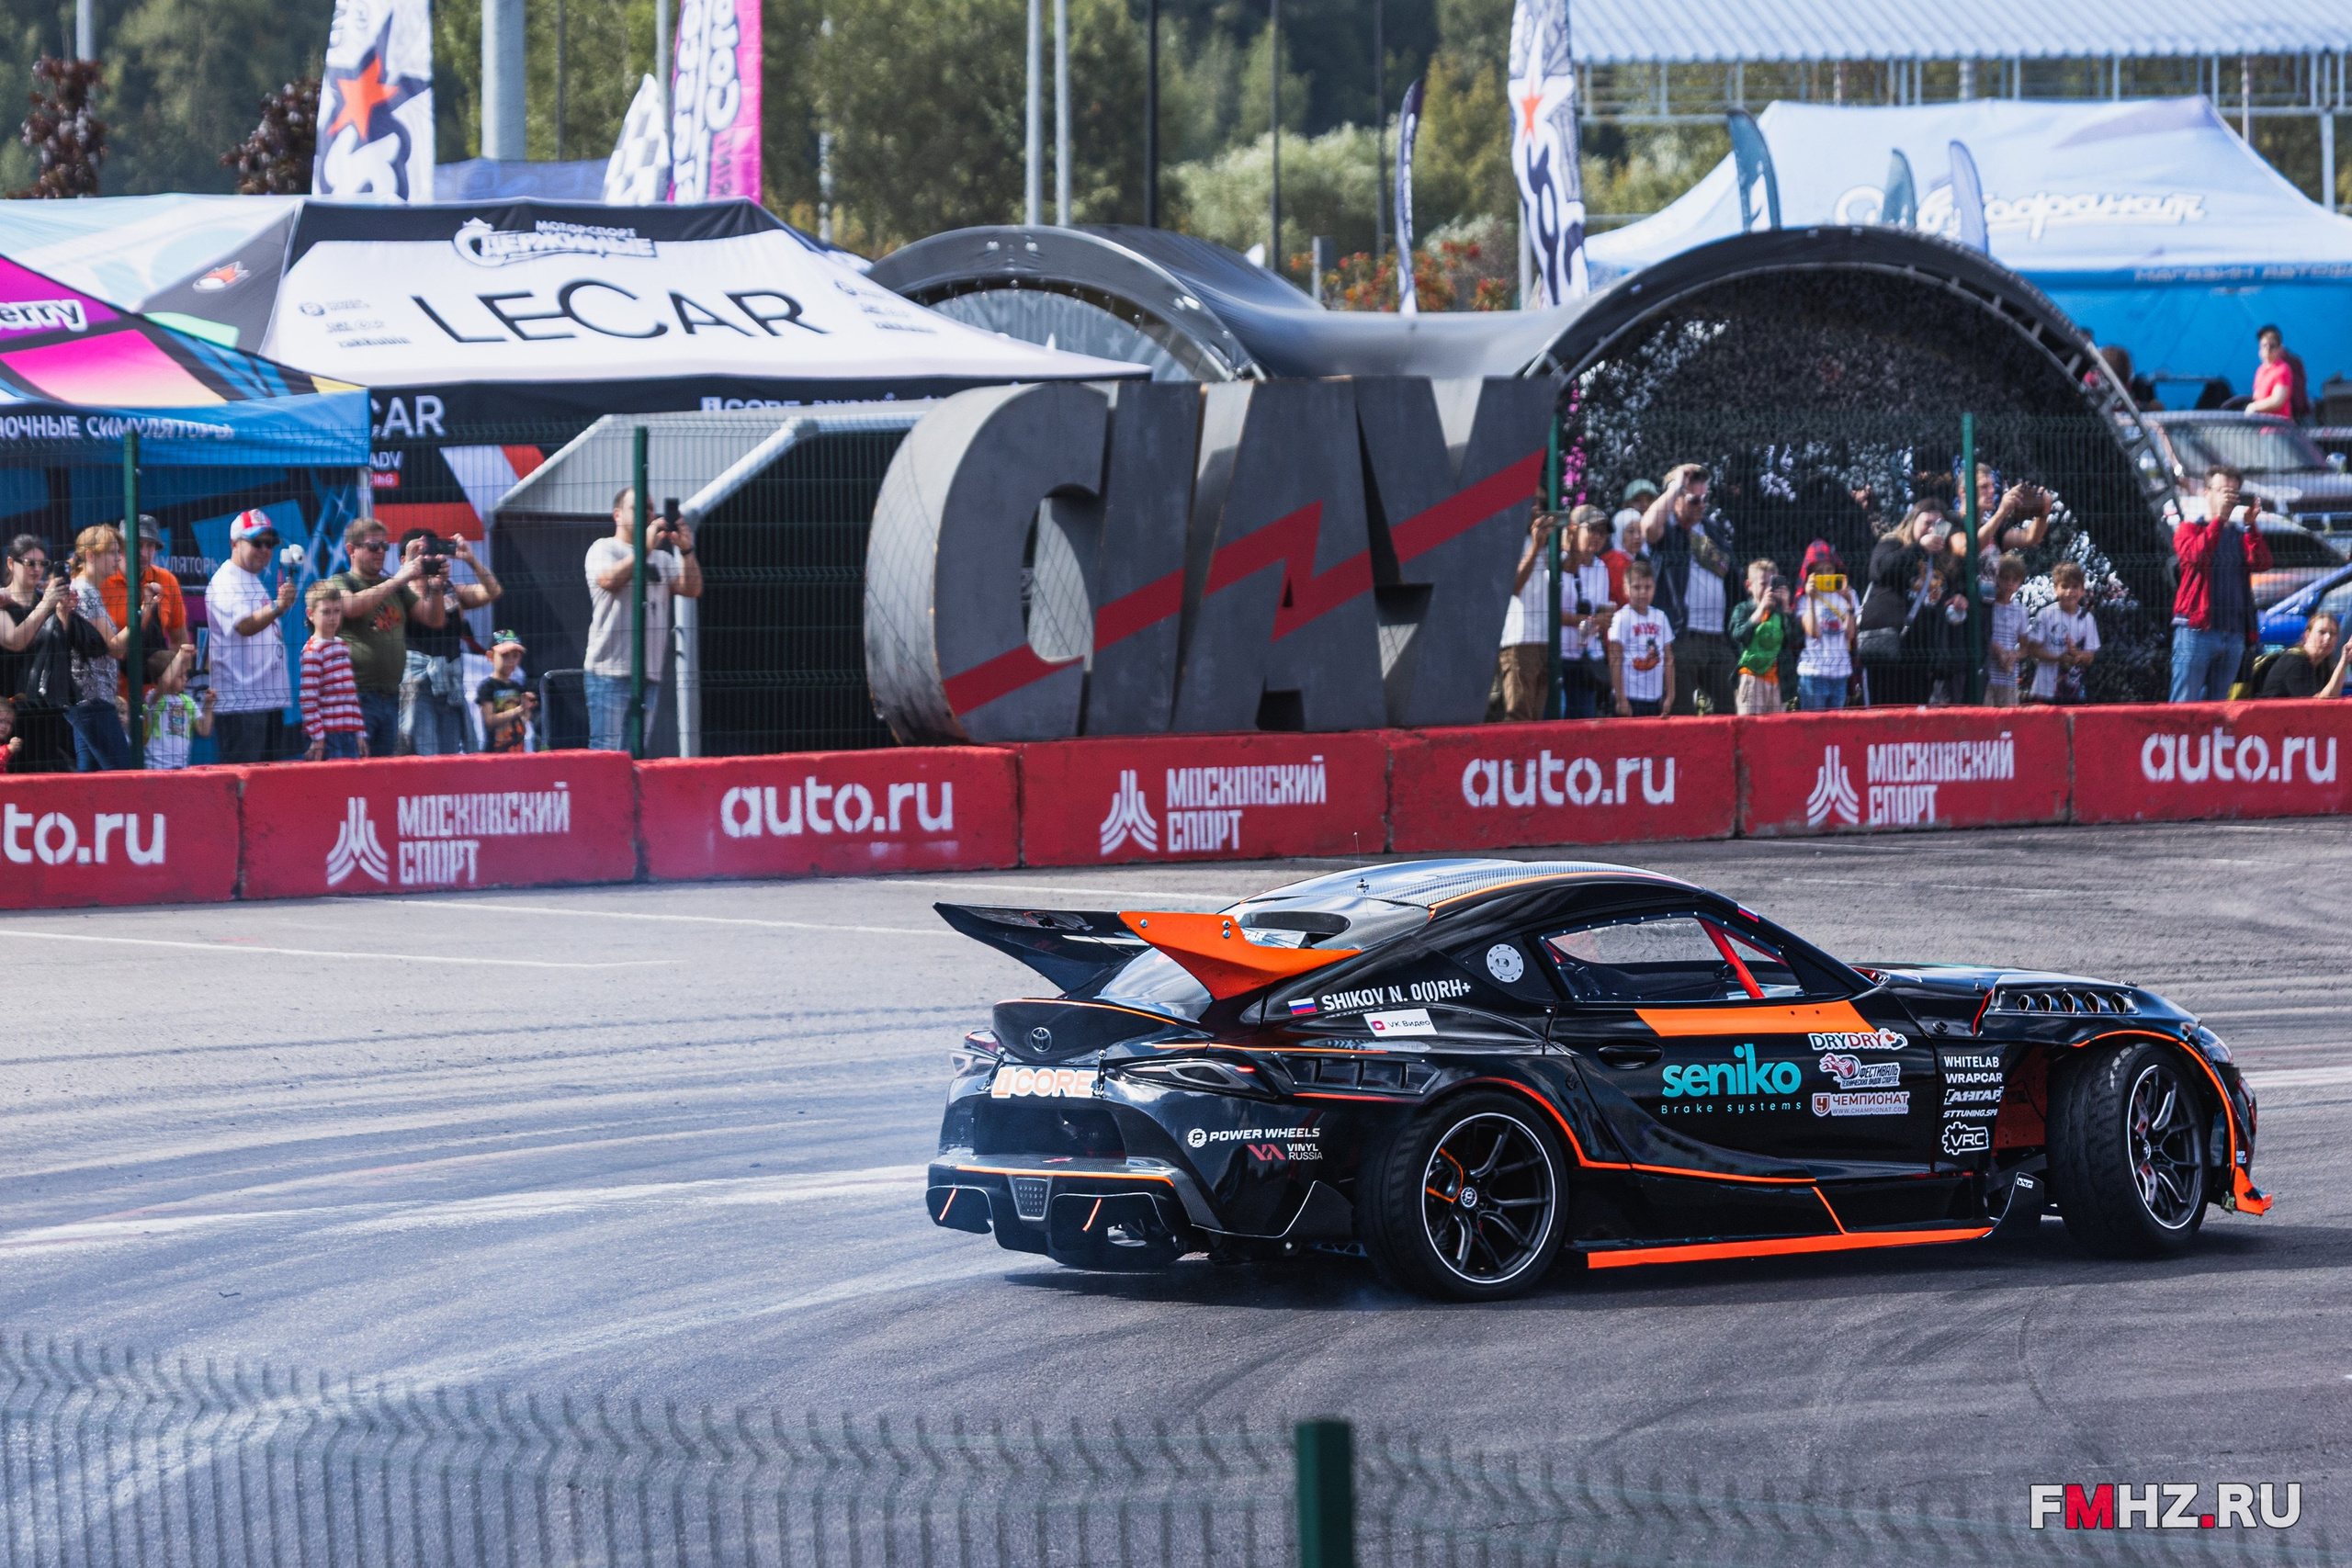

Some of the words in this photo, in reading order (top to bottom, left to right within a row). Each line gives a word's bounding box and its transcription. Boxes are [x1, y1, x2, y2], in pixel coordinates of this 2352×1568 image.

[410, 278, 832, 344] LECAR
[0, 416, 81, 439] ОЧНЫЕ
[86, 417, 235, 441] СИМУЛЯТОРЫ
[371, 395, 447, 439] AR
[1867, 731, 2015, 784] МОСКОВСКИЙ
[2142, 726, 2337, 784] auto.ru
[1166, 755, 1327, 808] МОСКОВСКИЙ
[1462, 750, 1676, 807] auto.ru
[397, 781, 571, 837] МОСКОВСКИЙ
[721, 776, 953, 838] auto.ru
[1868, 784, 1939, 826] СПОРТ
[4, 803, 165, 865] to.ru
[1167, 809, 1243, 852] СПОРТ
[398, 840, 480, 885] СПОРТ
[1321, 987, 1385, 1011] SHIKOV
[1387, 986, 1408, 1003] N.
[1403, 1019, 1430, 1028] Видео
[1810, 1033, 1882, 1048] DRYDRY
[1662, 1043, 1802, 1098] seniko
[1860, 1064, 1899, 1078] ФЕСТИВАЛЬ
[1944, 1056, 1999, 1067] WHITELAB
[1945, 1073, 2003, 1084] WRAPCAR
[1661, 1104, 1713, 1114] Brake
[1727, 1101, 1802, 1114] systems
[1832, 1106, 1907, 1114] WWW.CHAMPIONAT.COM
[1833, 1094, 1908, 1106] ЧЕМПИОНАТ
[1209, 1129, 1262, 1142] POWER
[1265, 1128, 1320, 1138] WHEELS
[1951, 1133, 1985, 1146] VRC
[1286, 1144, 1319, 1152] VINYL
[1288, 1152, 1323, 1160] RUSSIA
